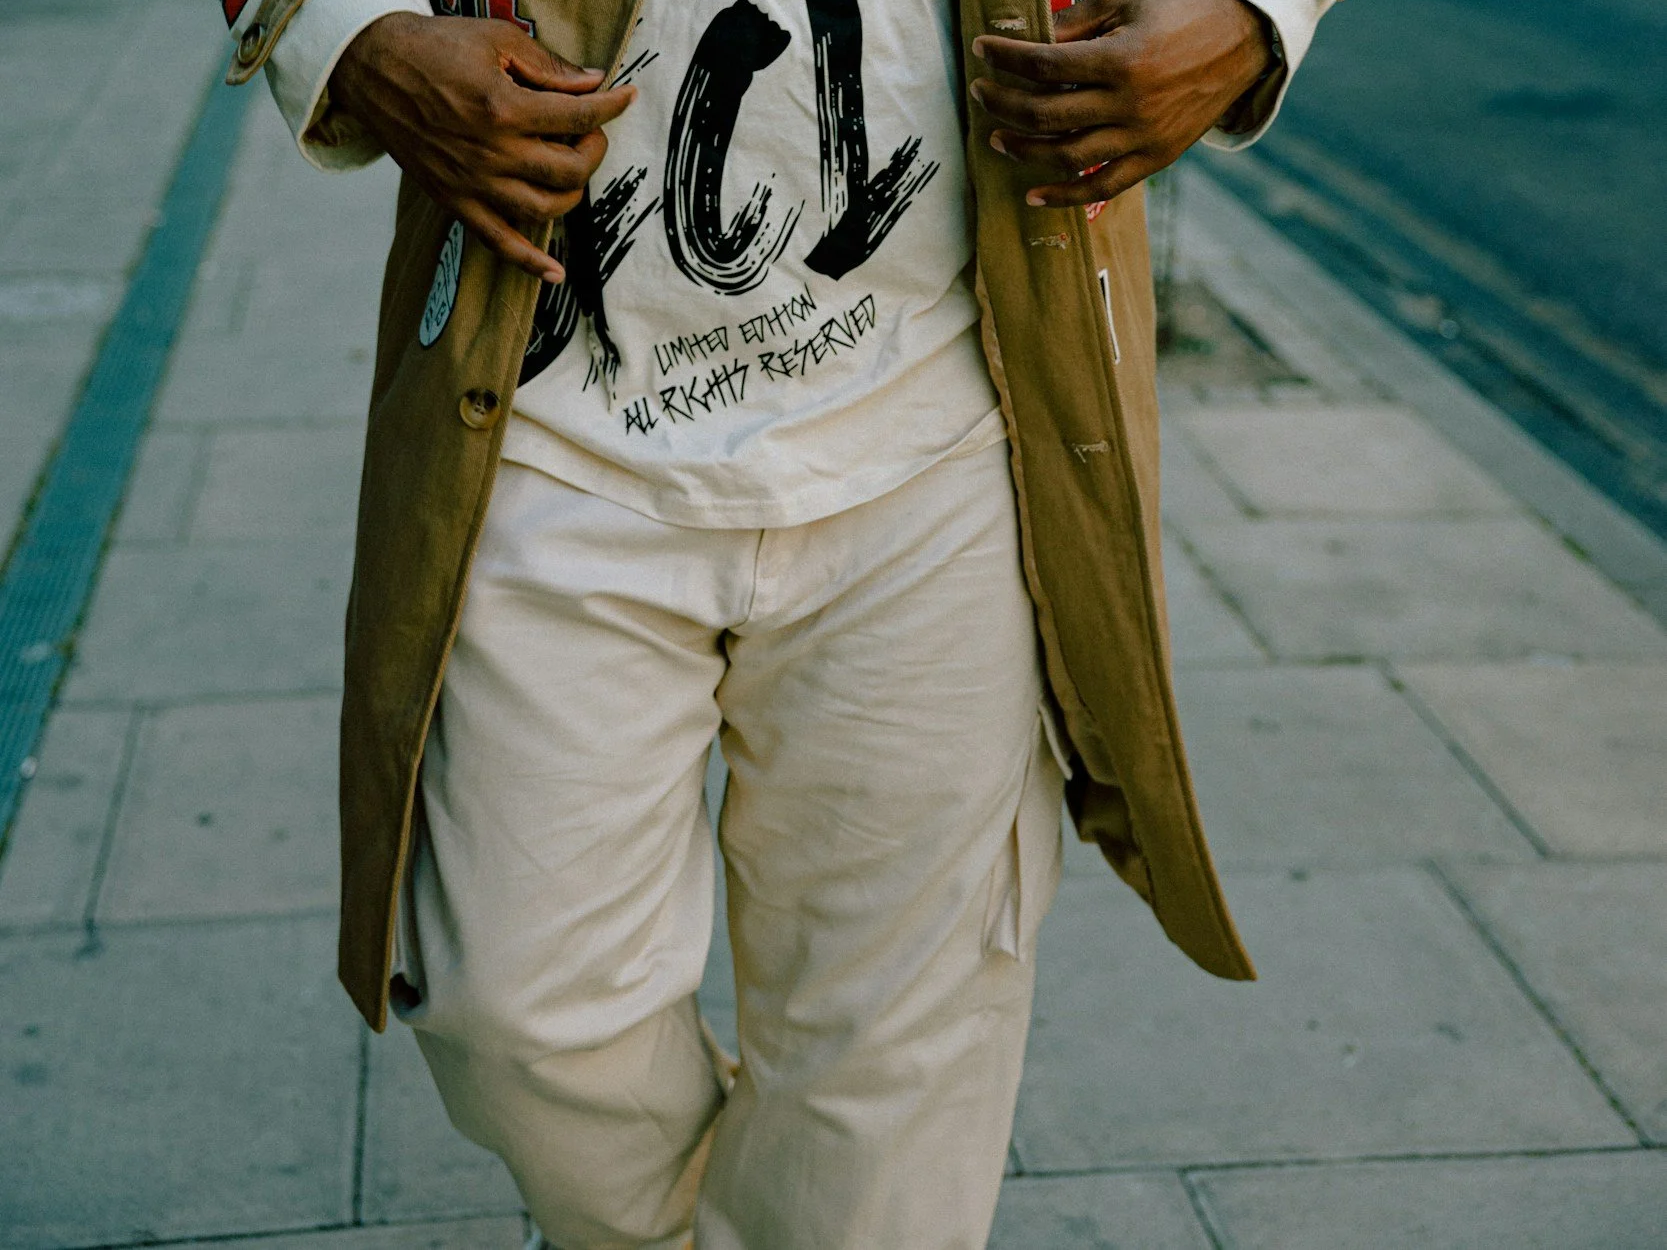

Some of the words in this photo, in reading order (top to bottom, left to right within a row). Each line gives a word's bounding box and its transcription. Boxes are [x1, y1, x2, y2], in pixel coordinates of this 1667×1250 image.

[623, 397, 659, 437] ALL
[659, 358, 750, 424] RIGHTS
[757, 293, 876, 382] RESERVED
[653, 325, 729, 377] LIMITED
[738, 282, 818, 344] EDITION
